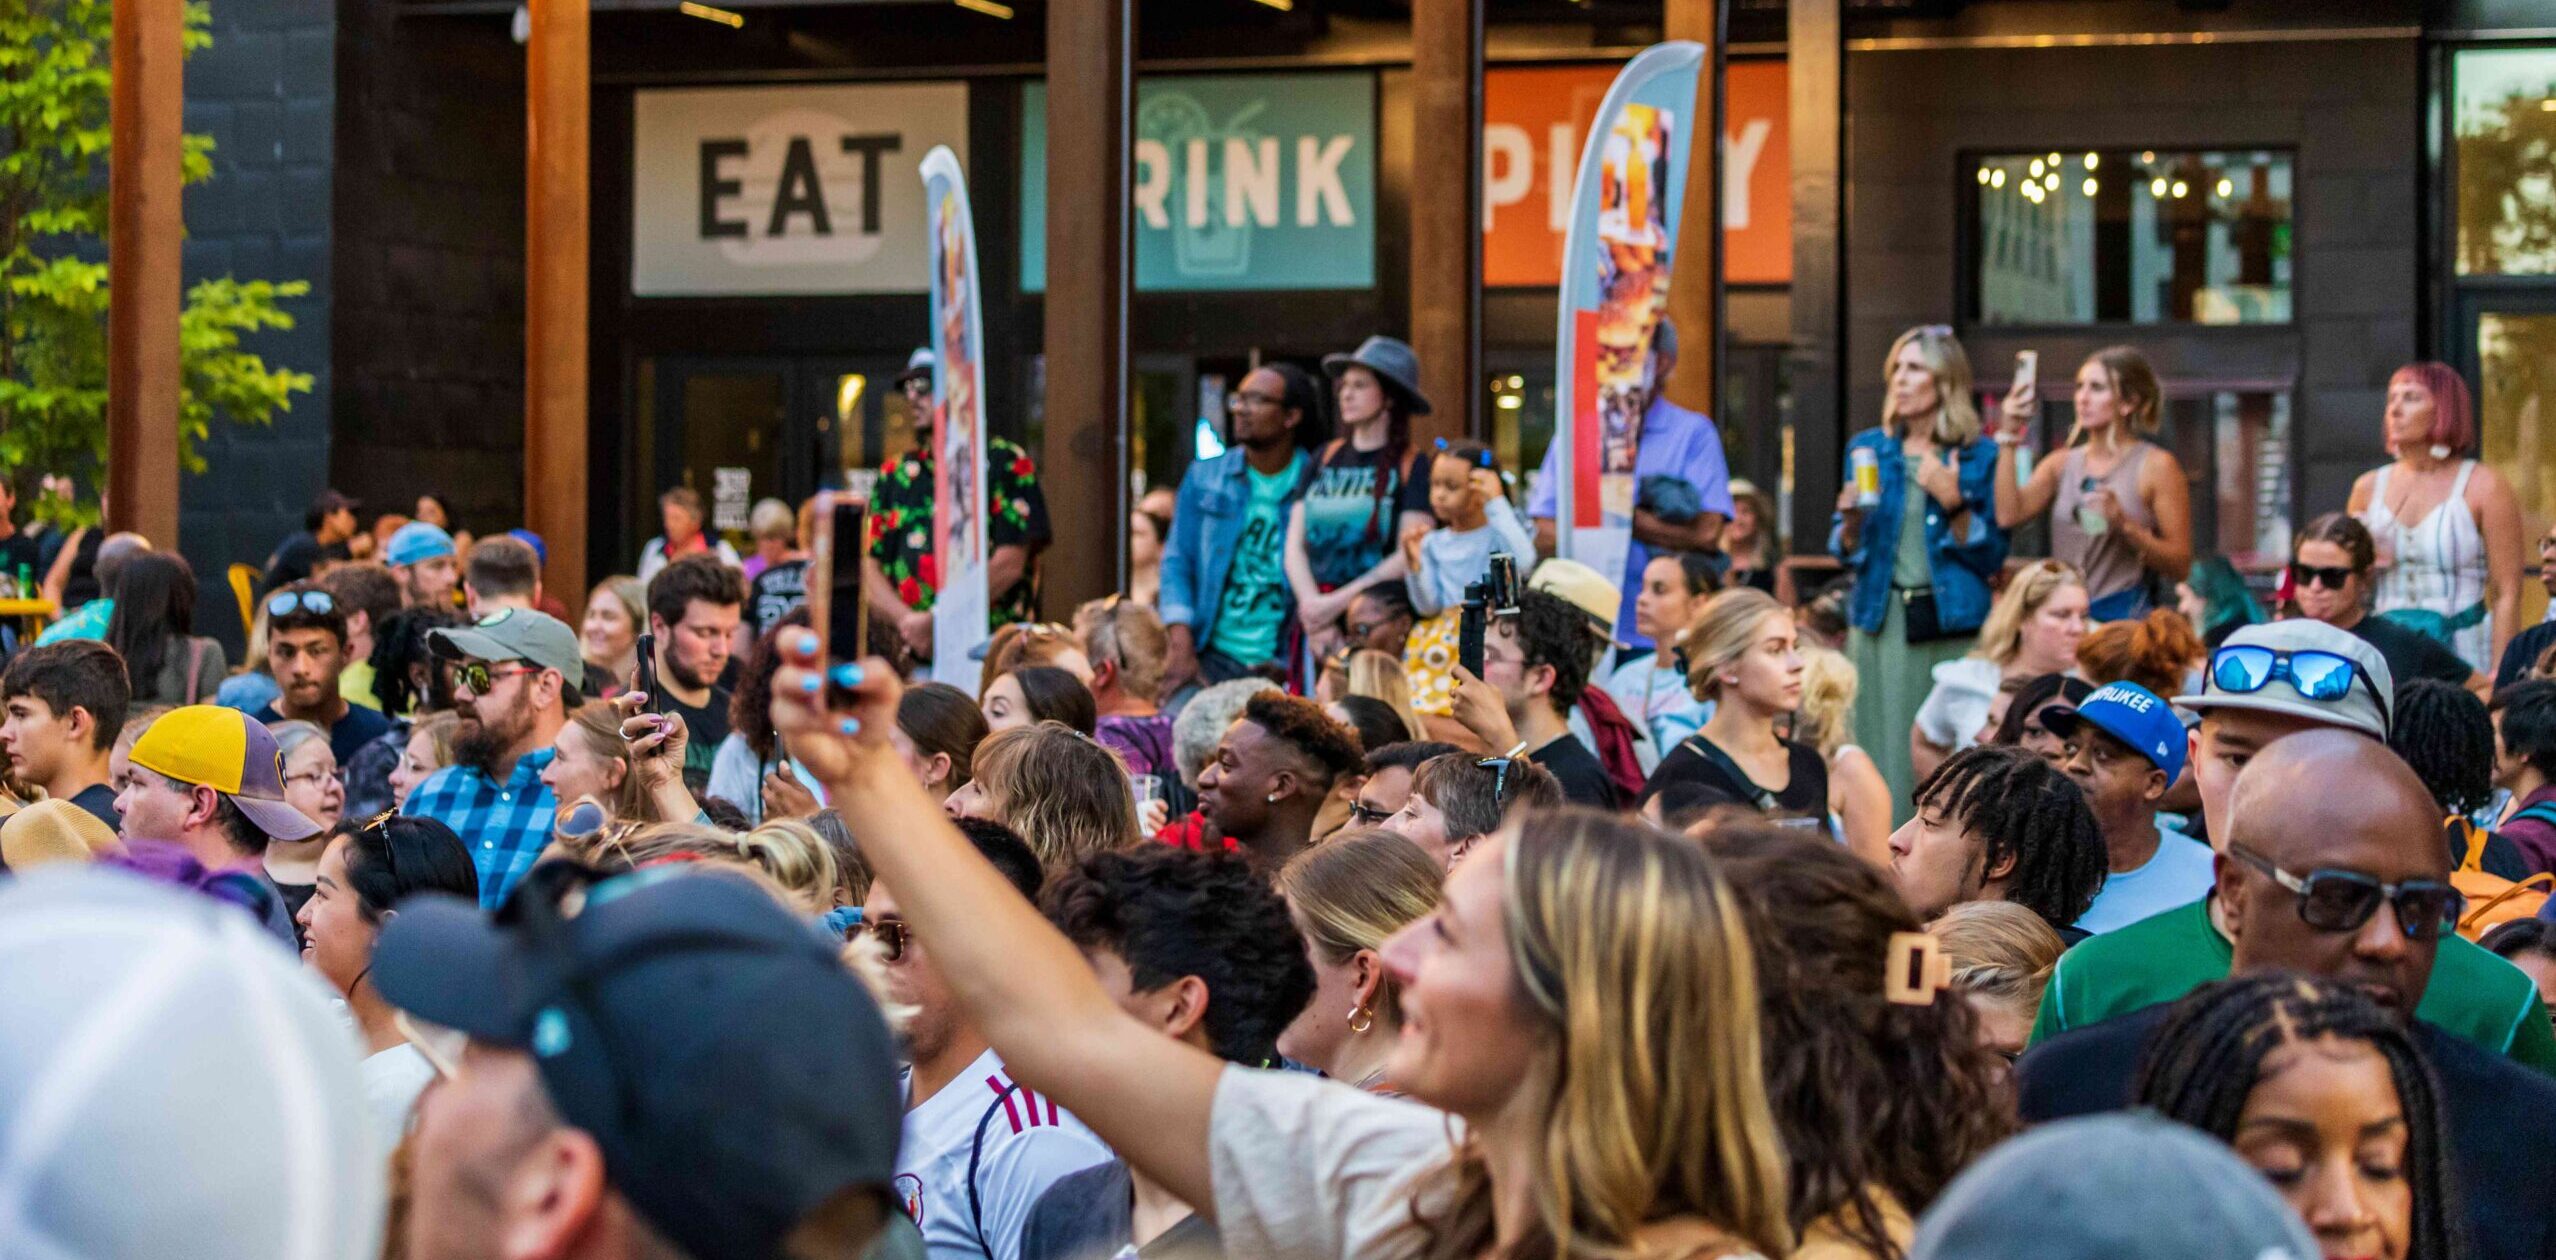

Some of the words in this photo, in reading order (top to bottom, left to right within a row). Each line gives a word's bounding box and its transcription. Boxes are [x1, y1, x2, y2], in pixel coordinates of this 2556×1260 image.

[700, 134, 903, 237] EAT
[1134, 136, 1355, 228] RINK
[1483, 119, 1772, 231] PLY
